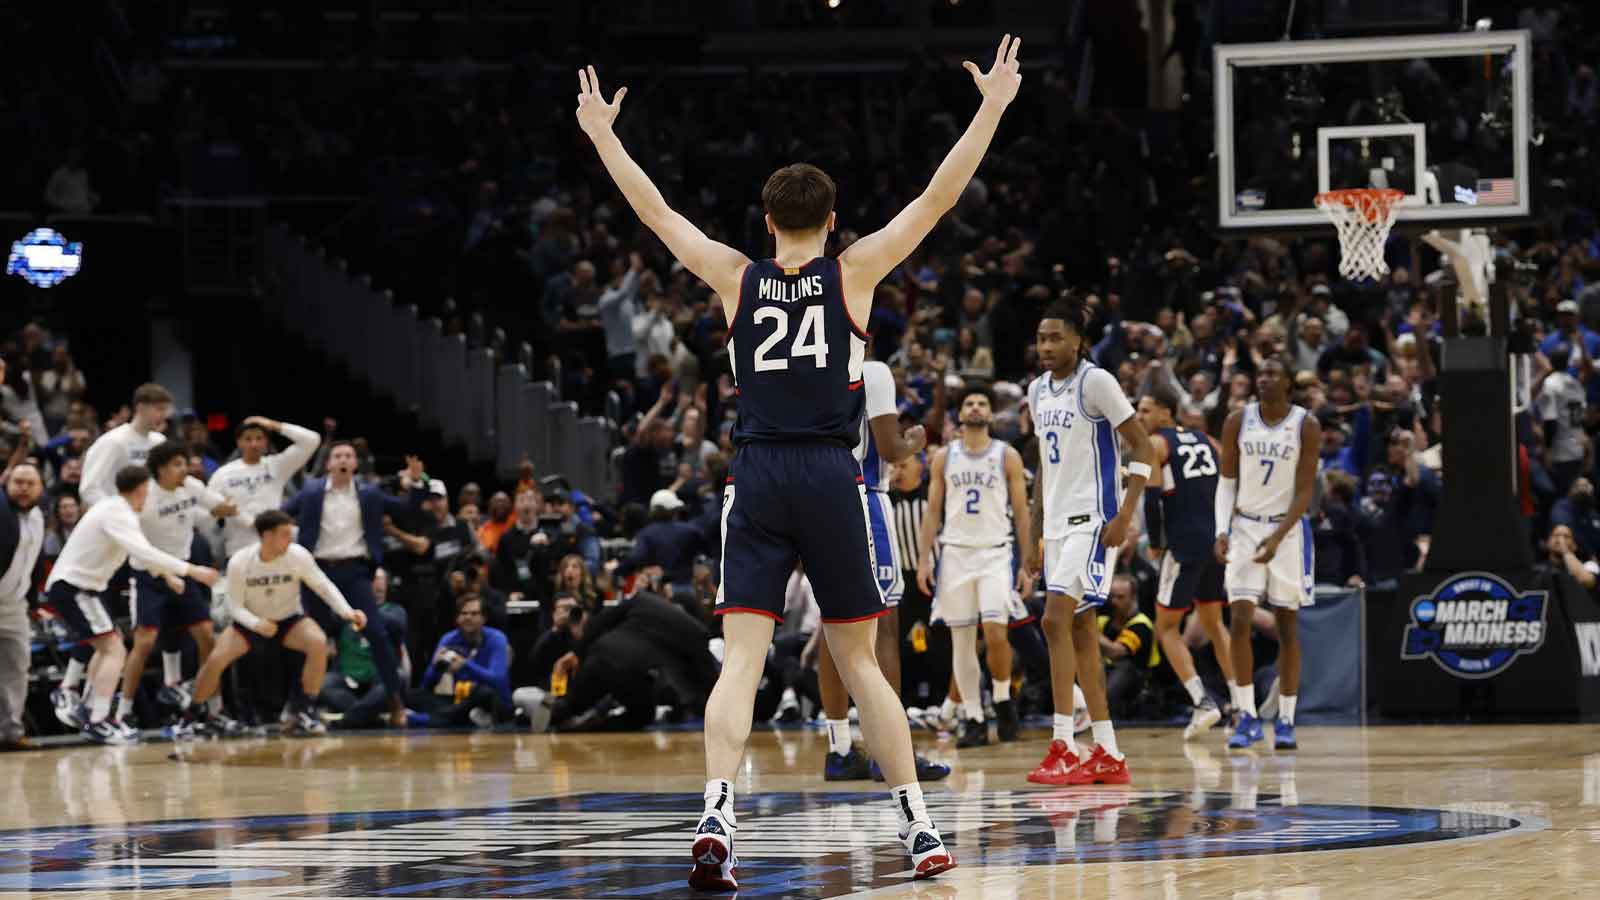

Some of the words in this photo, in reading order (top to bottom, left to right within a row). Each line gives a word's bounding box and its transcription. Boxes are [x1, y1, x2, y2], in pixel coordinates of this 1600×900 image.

[758, 275, 823, 303] MULLINS
[753, 304, 830, 372] 24
[1046, 431, 1060, 464] 3
[1243, 441, 1295, 461] DUKE
[1177, 443, 1217, 479] 23
[1260, 459, 1274, 485] 7
[950, 471, 998, 490] DUKE
[966, 489, 981, 514] 2
[1435, 600, 1509, 623] MARCH
[1444, 621, 1541, 645] MADNESS
